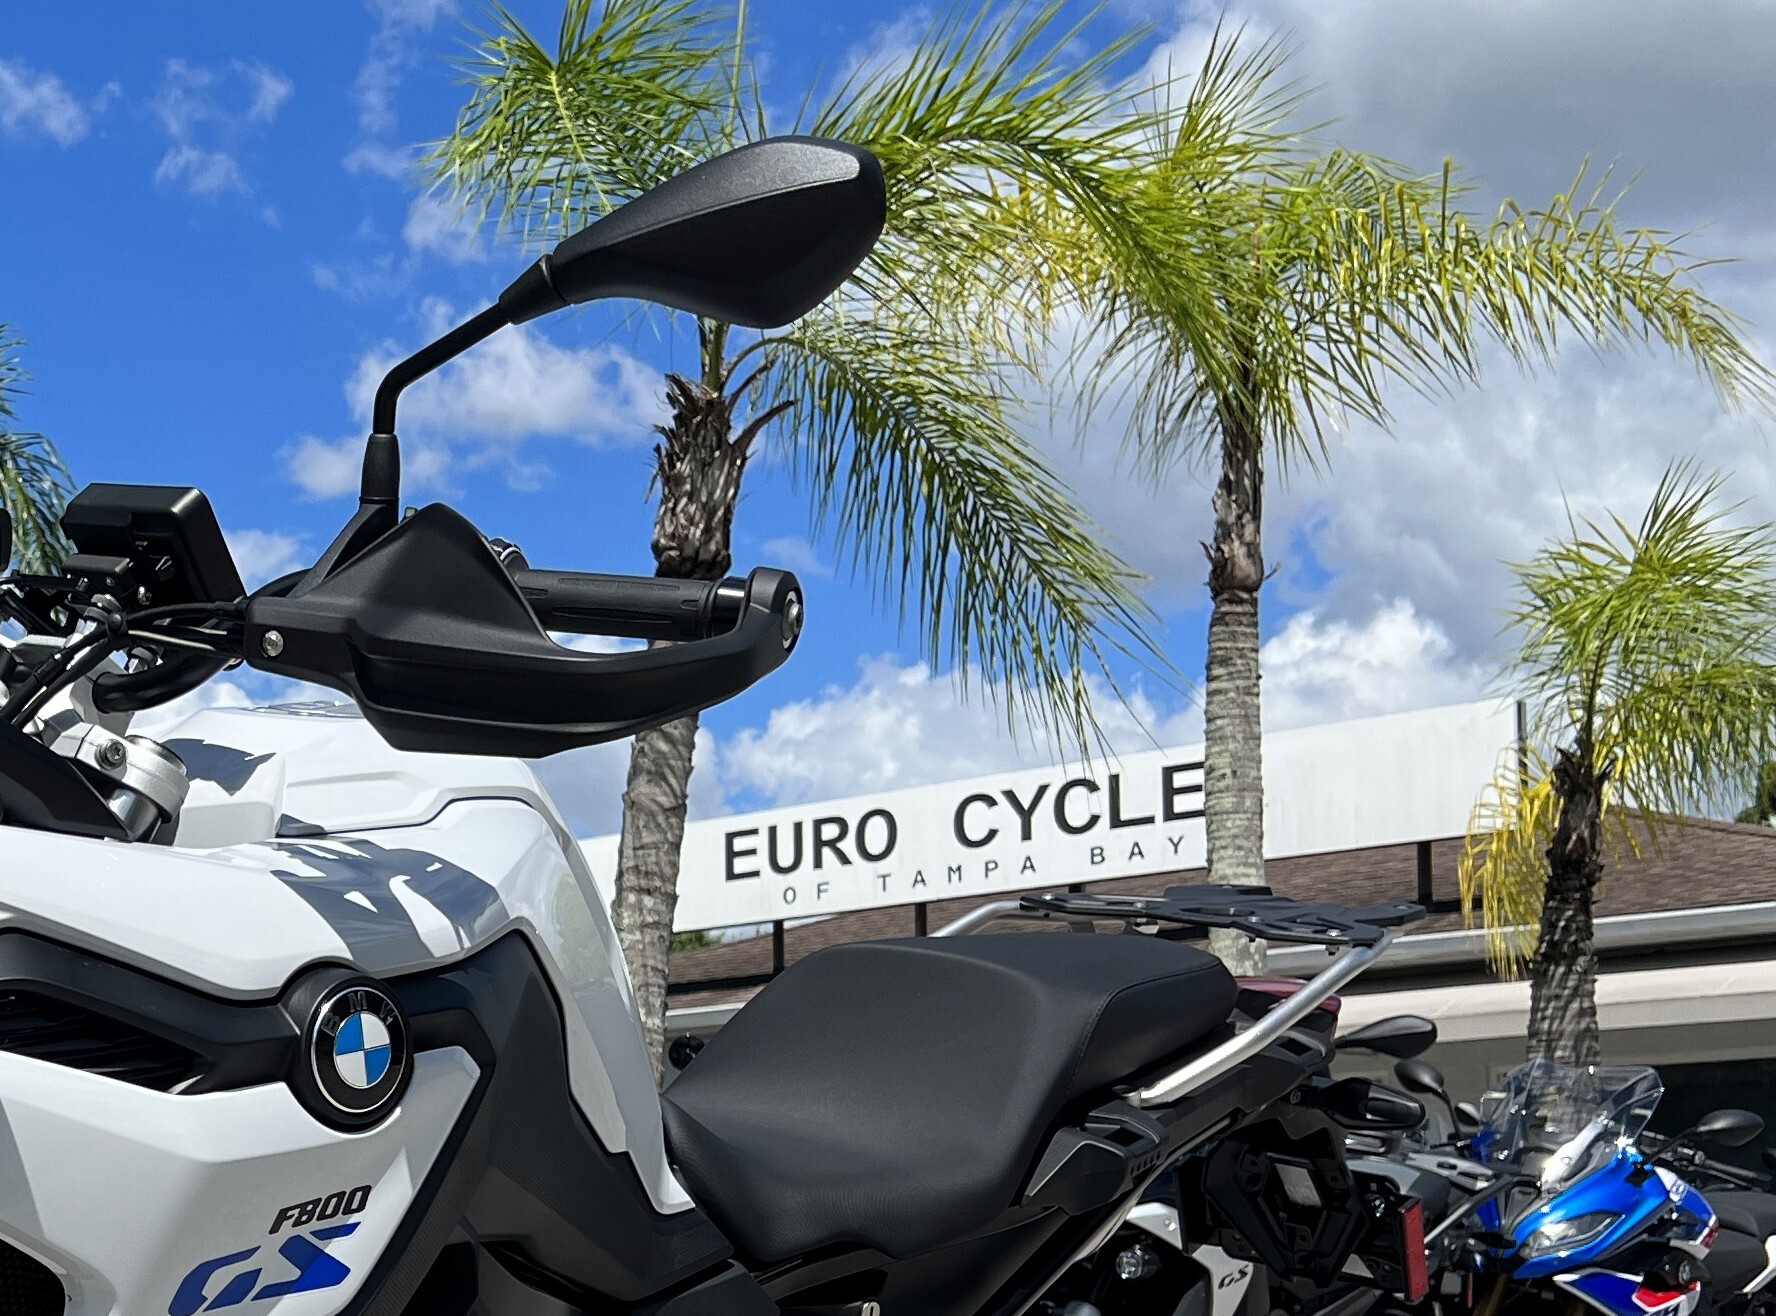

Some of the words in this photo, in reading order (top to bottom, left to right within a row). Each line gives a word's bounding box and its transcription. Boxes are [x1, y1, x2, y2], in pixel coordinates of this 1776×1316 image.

[724, 808, 899, 882] EURO
[783, 881, 830, 905] OF
[877, 855, 1037, 894] TAMPA
[1089, 835, 1185, 866] BAY
[320, 990, 399, 1037] BMW
[268, 1184, 373, 1235] F800
[1217, 1264, 1250, 1291] GS
